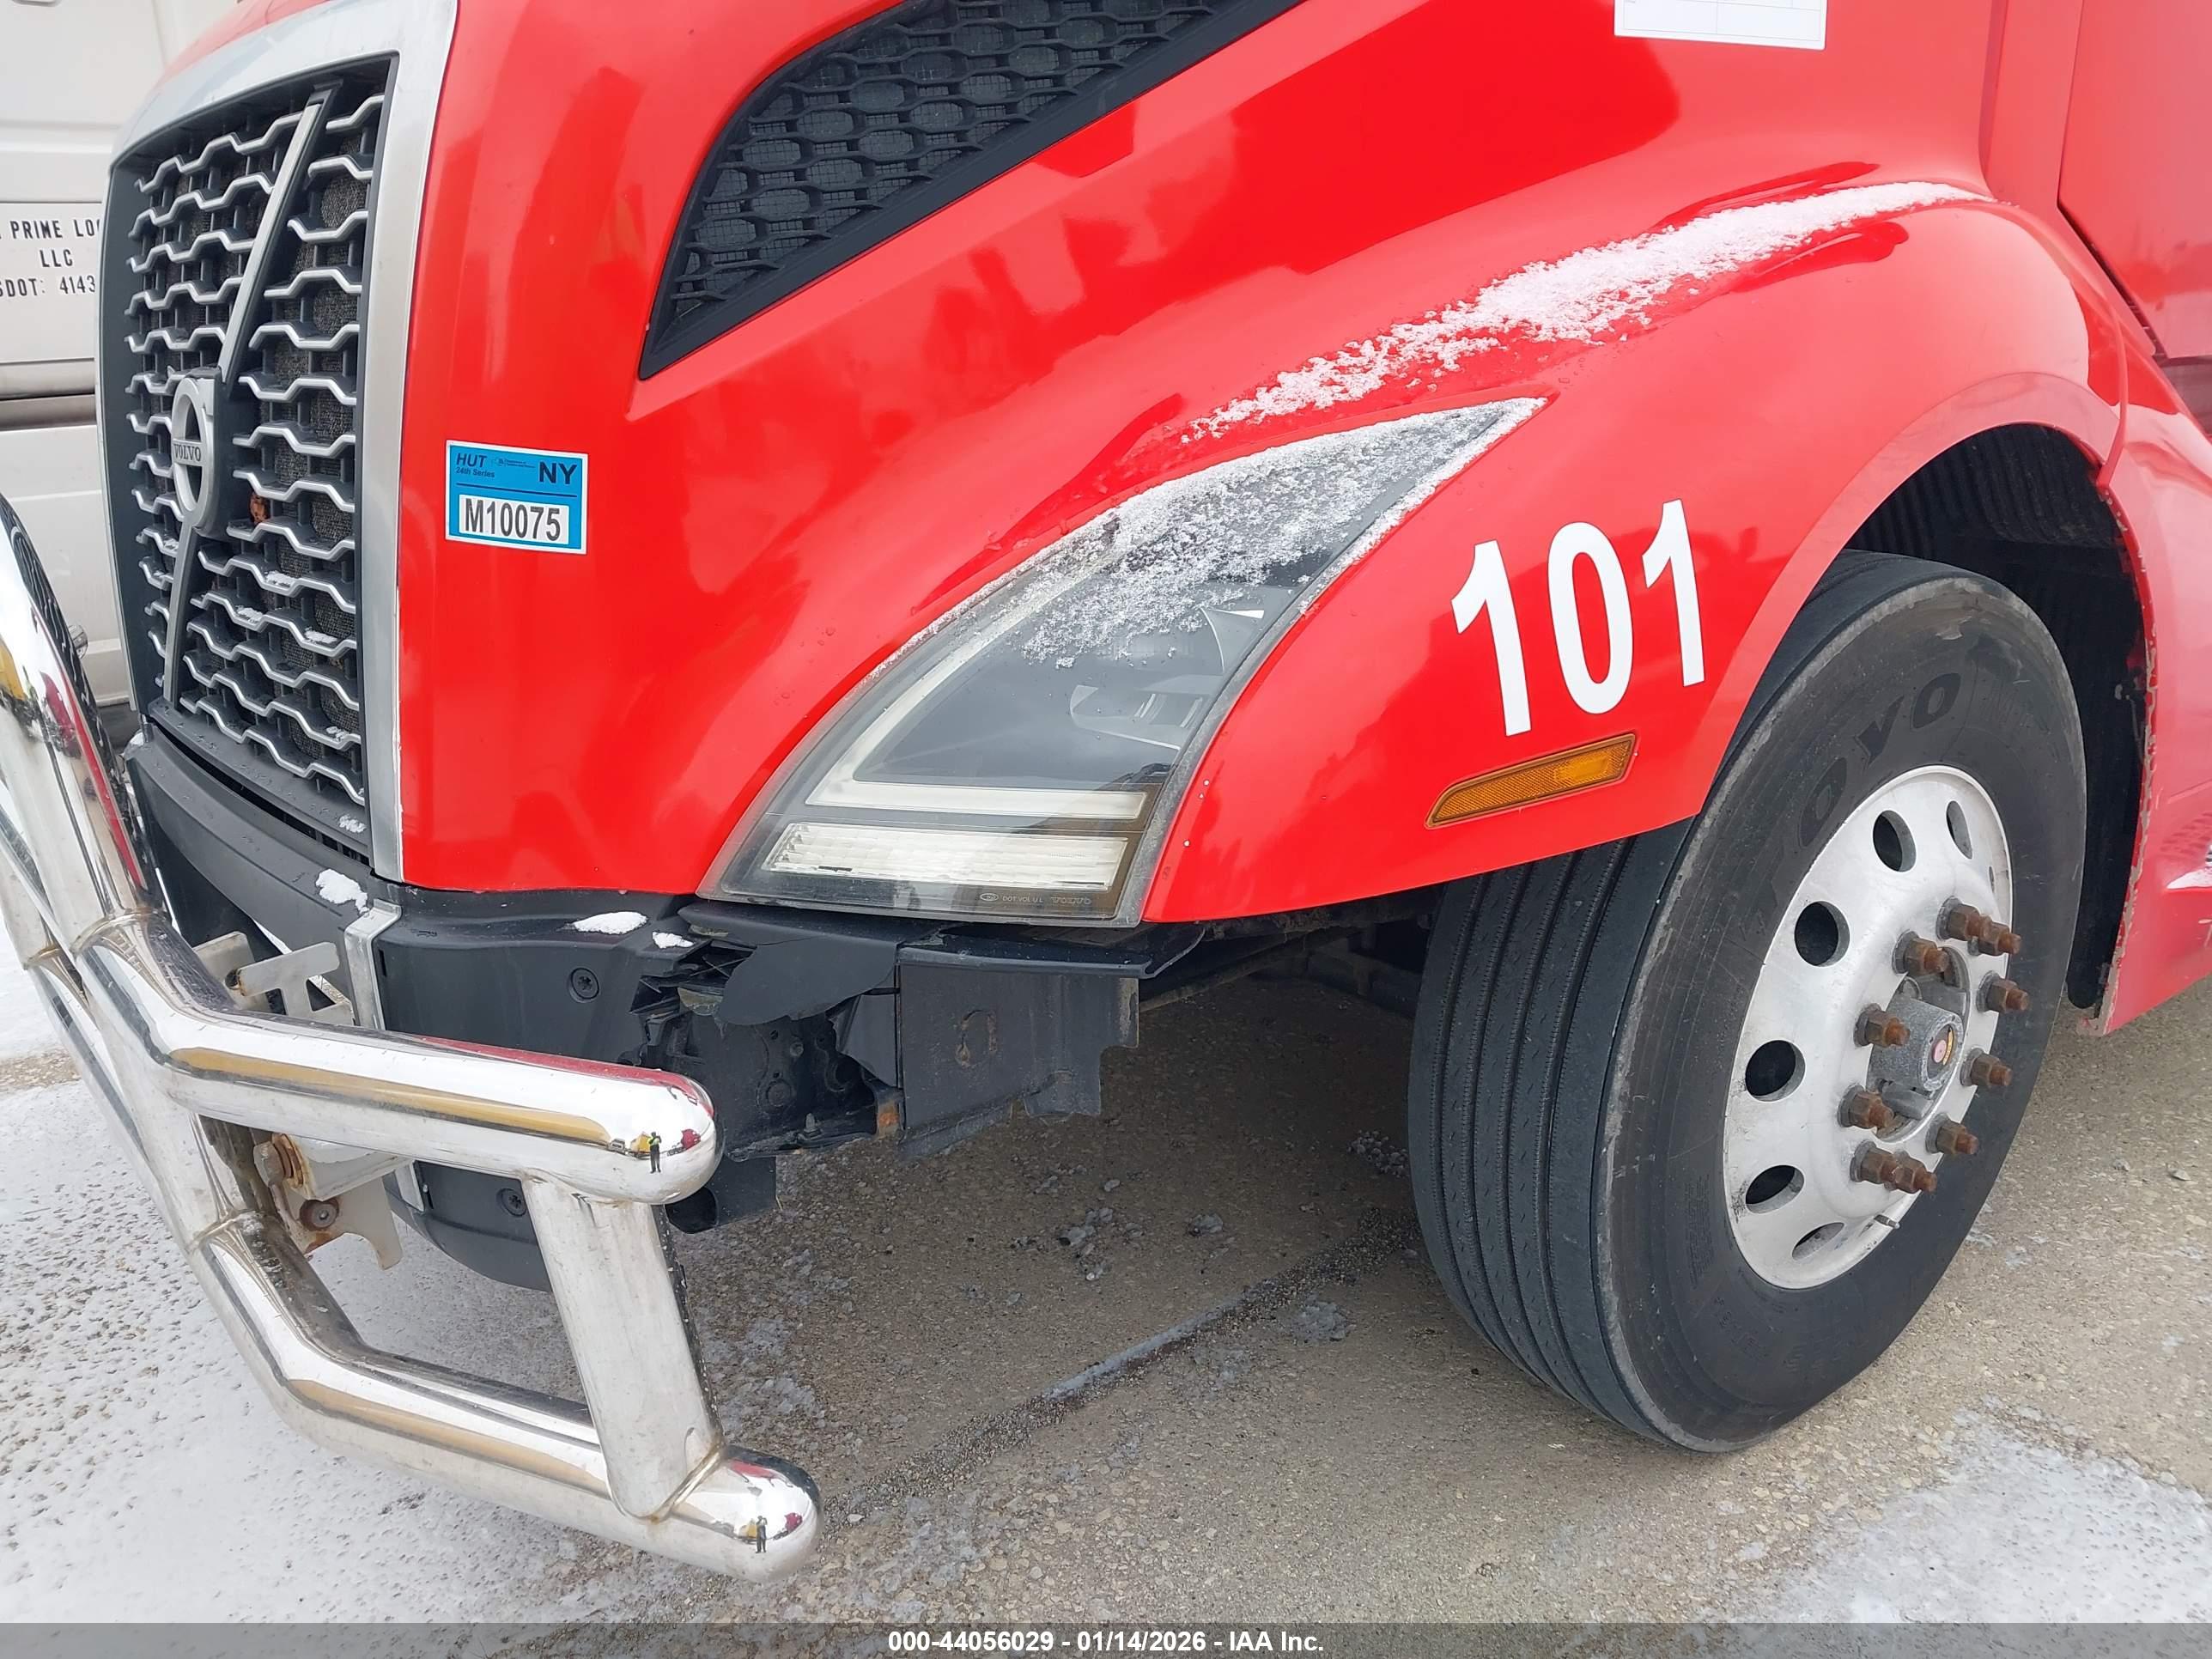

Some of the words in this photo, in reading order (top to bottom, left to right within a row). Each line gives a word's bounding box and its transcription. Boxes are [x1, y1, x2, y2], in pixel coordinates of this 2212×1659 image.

[9, 220, 64, 239] PRIME
[74, 218, 100, 238] LO
[40, 249, 74, 268] LLC
[59, 275, 96, 295] 4143
[173, 443, 202, 463] VOLVO
[456, 453, 488, 468] HUT
[472, 468, 495, 478] Series
[539, 461, 578, 485] NY
[465, 498, 561, 542] M10075
[1451, 498, 1705, 737] 101
